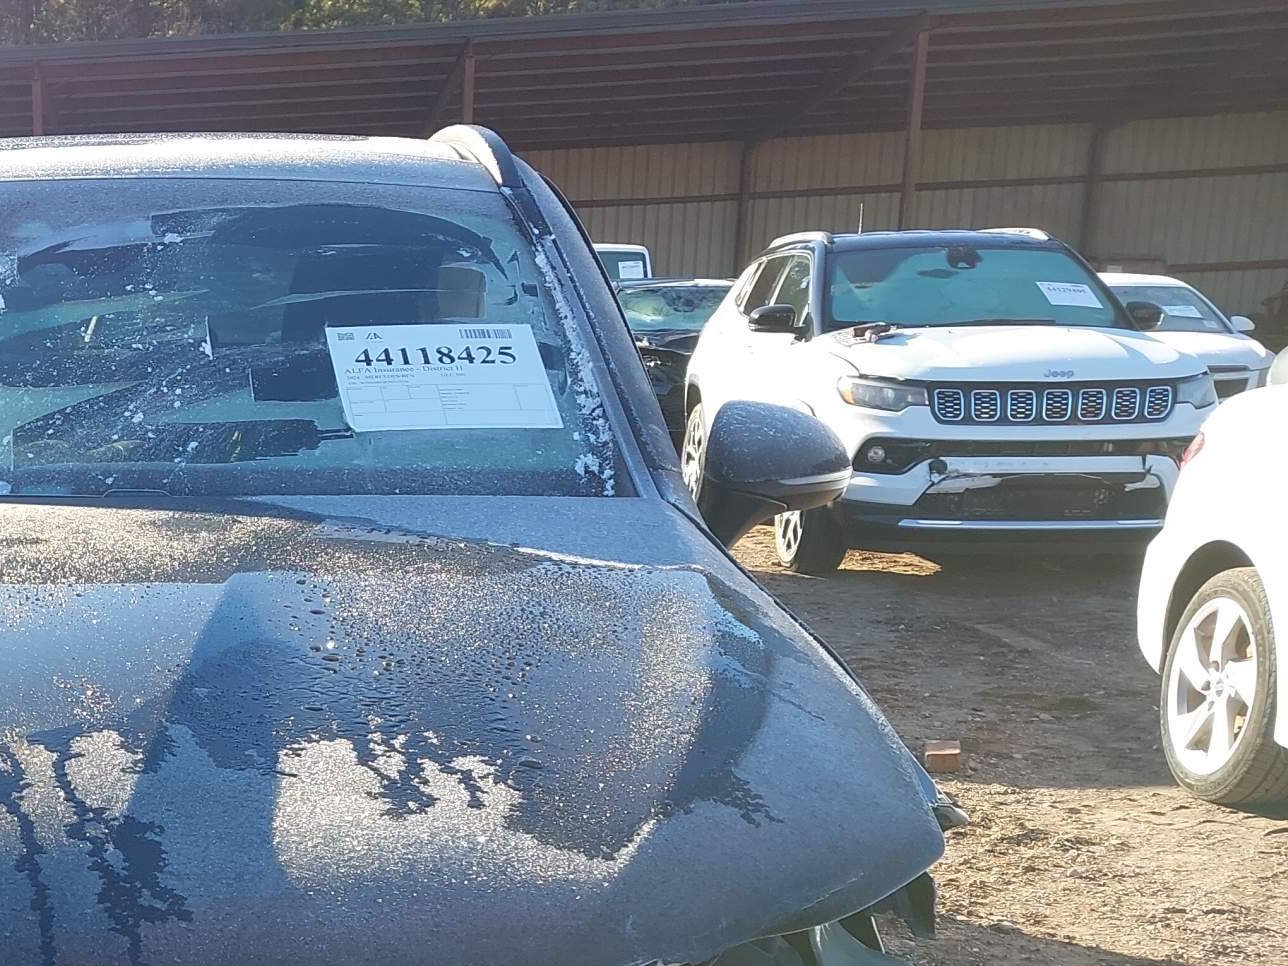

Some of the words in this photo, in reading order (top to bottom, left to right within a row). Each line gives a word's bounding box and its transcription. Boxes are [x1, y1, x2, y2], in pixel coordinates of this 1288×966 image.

[355, 345, 517, 367] 44118425
[345, 367, 372, 375] ALFA
[1043, 369, 1074, 379] Jeep
